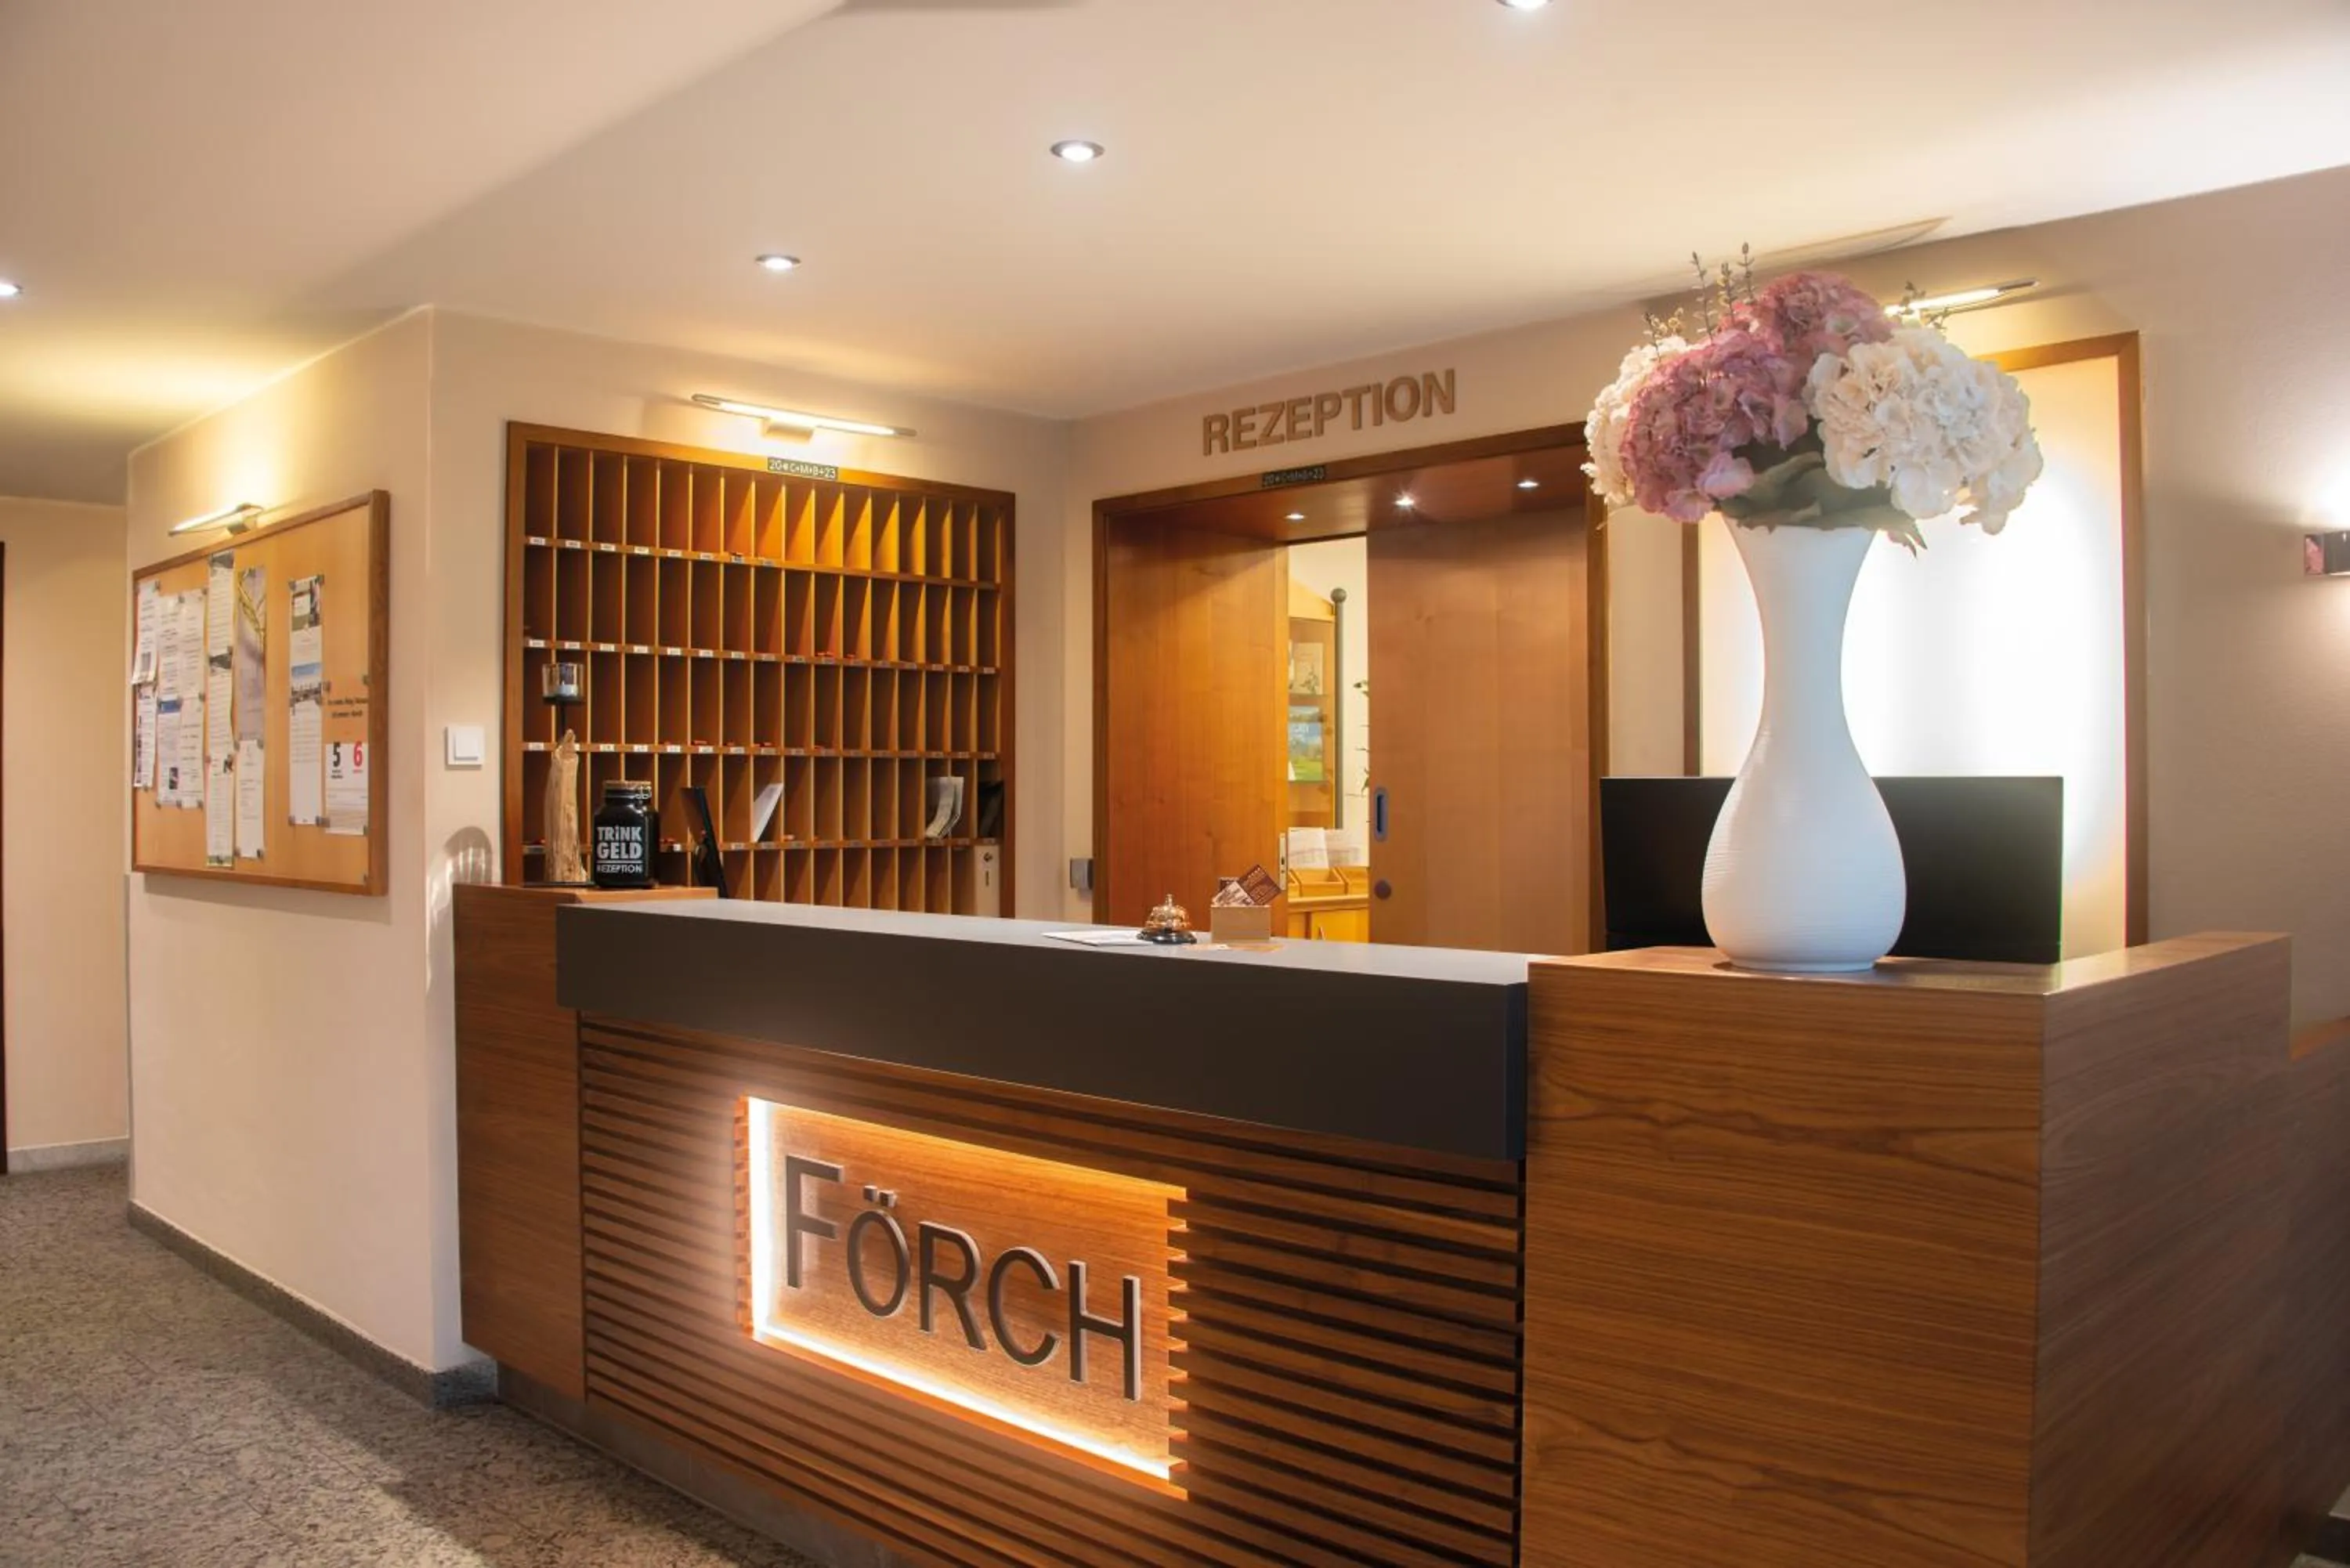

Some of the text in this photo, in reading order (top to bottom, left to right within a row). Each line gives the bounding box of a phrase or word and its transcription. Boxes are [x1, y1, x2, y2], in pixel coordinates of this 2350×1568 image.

[1202, 368, 1455, 456] REZEPTION
[333, 741, 363, 768] 5 6
[597, 842, 643, 859] GELD
[786, 1154, 1141, 1402] FÖRCH
